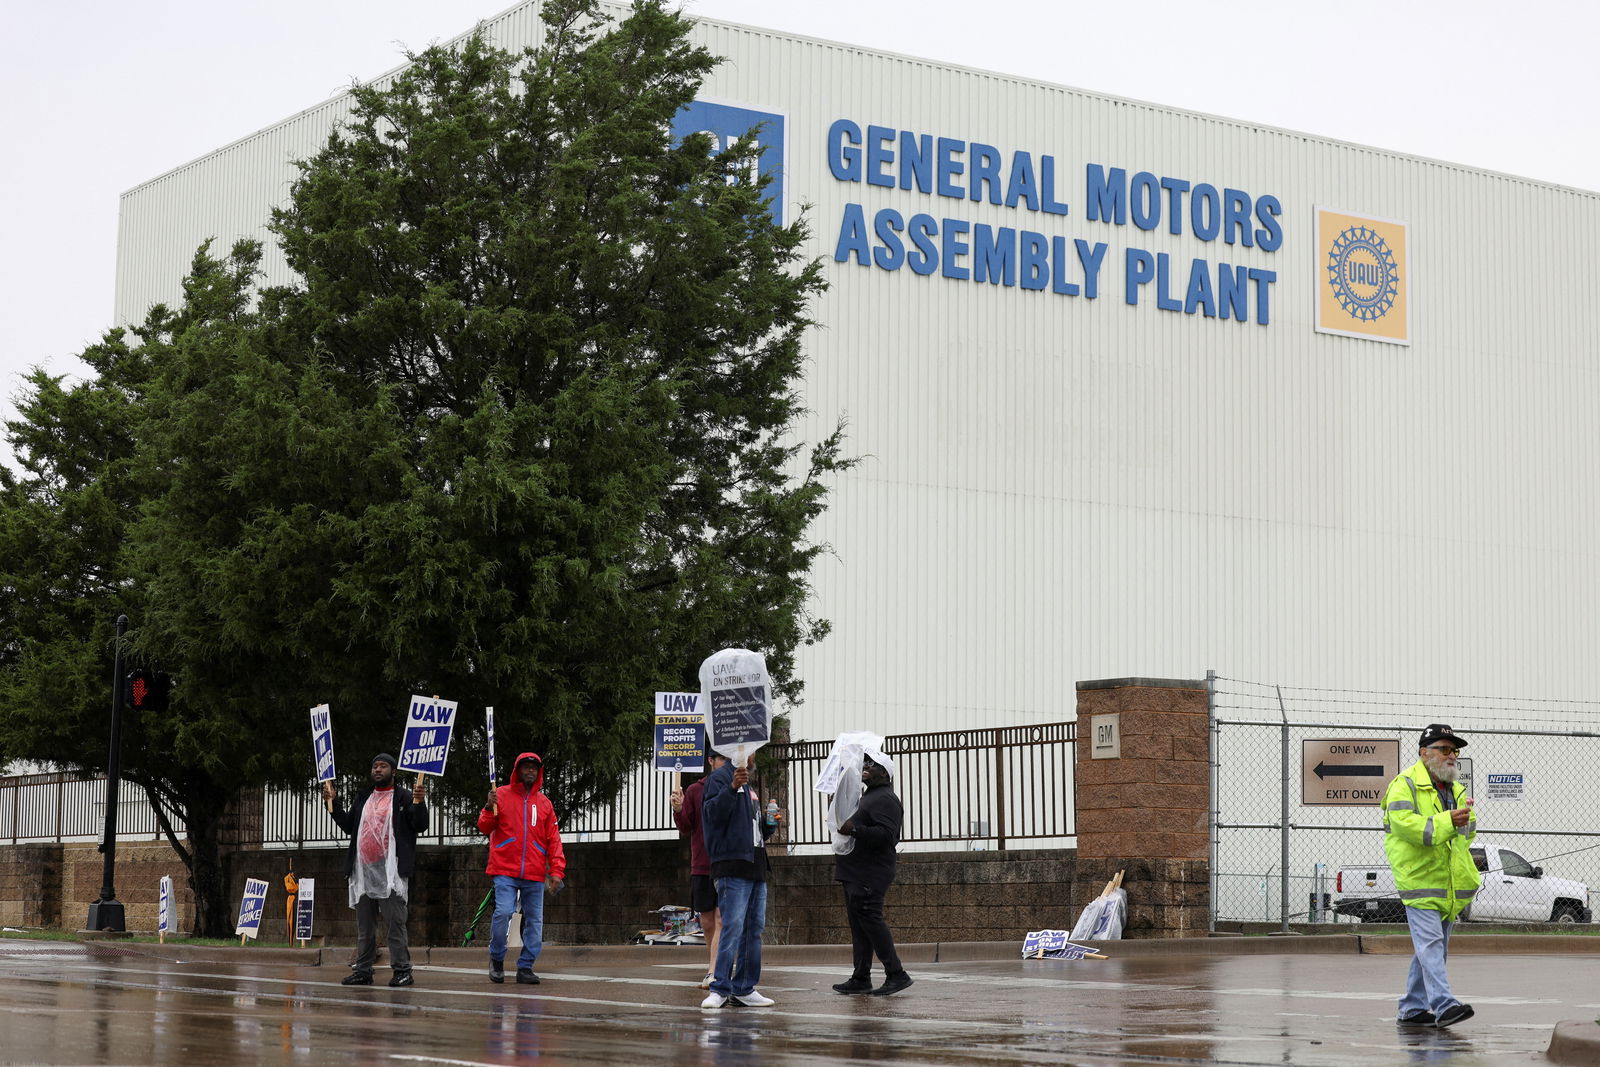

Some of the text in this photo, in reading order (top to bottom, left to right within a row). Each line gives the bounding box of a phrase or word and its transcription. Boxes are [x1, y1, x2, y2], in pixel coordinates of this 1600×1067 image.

[828, 120, 1283, 252] GENERAL MOTORS
[835, 204, 1277, 325] ASSEMBLY PLANT
[1348, 260, 1379, 287] UAW
[712, 663, 737, 676] UAW
[713, 677, 723, 687] ON
[663, 694, 698, 712] UAW
[412, 702, 453, 725] UAW
[658, 716, 688, 724] STAND
[312, 711, 328, 732] UAW
[419, 729, 436, 747] ON
[1098, 725, 1113, 743] GM
[403, 745, 445, 766] STRIKE
[1330, 745, 1377, 754] ONE WAY
[1489, 775, 1521, 783] NOTICE
[1326, 790, 1380, 799] EXIT ONLY
[246, 881, 266, 896] UAW
[245, 899, 256, 912] ON
[240, 909, 261, 925] STRIKE
[1028, 931, 1065, 939] UAW
[1026, 941, 1062, 951] STRIKE
